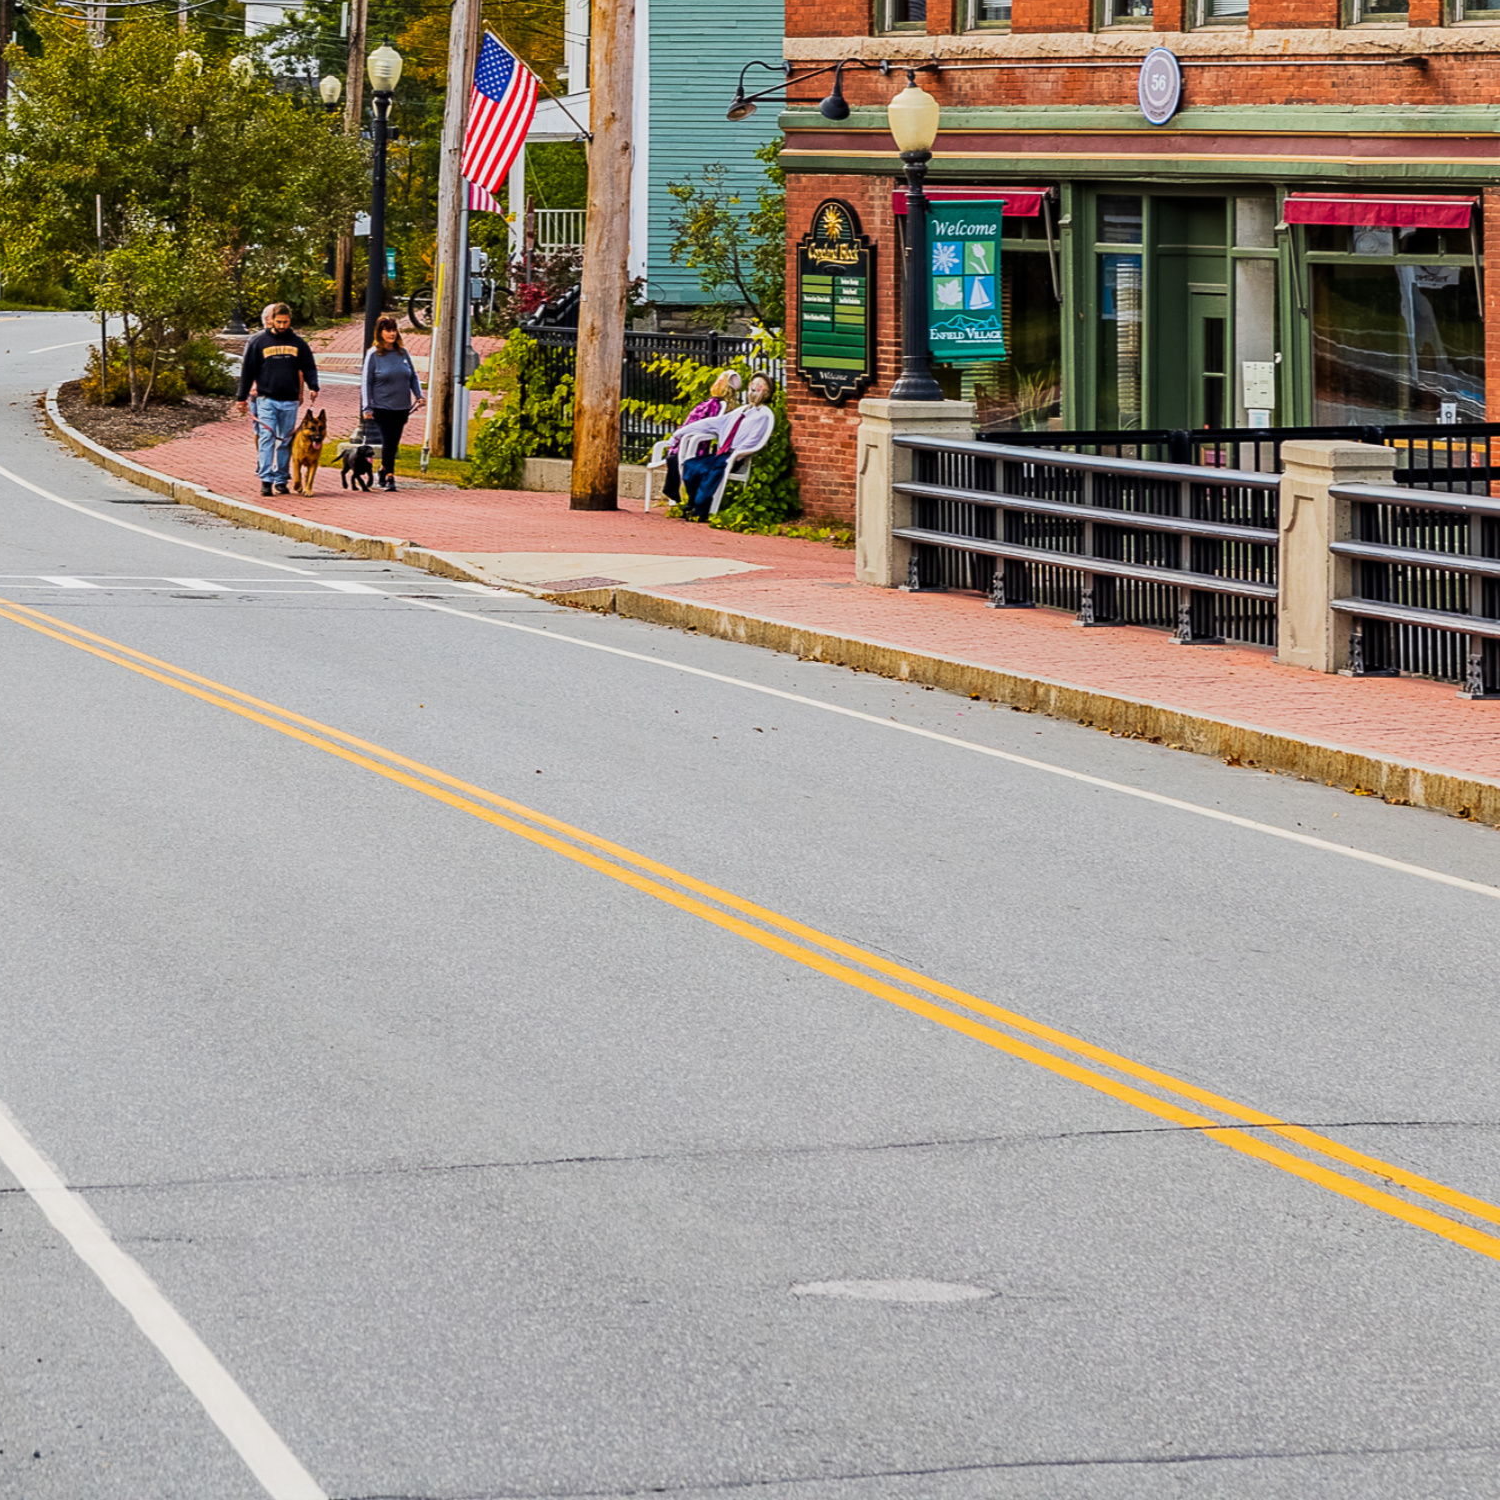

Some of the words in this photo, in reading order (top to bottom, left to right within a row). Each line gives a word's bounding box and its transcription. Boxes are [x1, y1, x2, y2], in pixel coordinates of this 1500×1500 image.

[1151, 73, 1167, 91] 56
[931, 219, 997, 236] Welcome
[929, 328, 965, 340] ENFIELD
[965, 327, 1002, 339] VILLAGE
